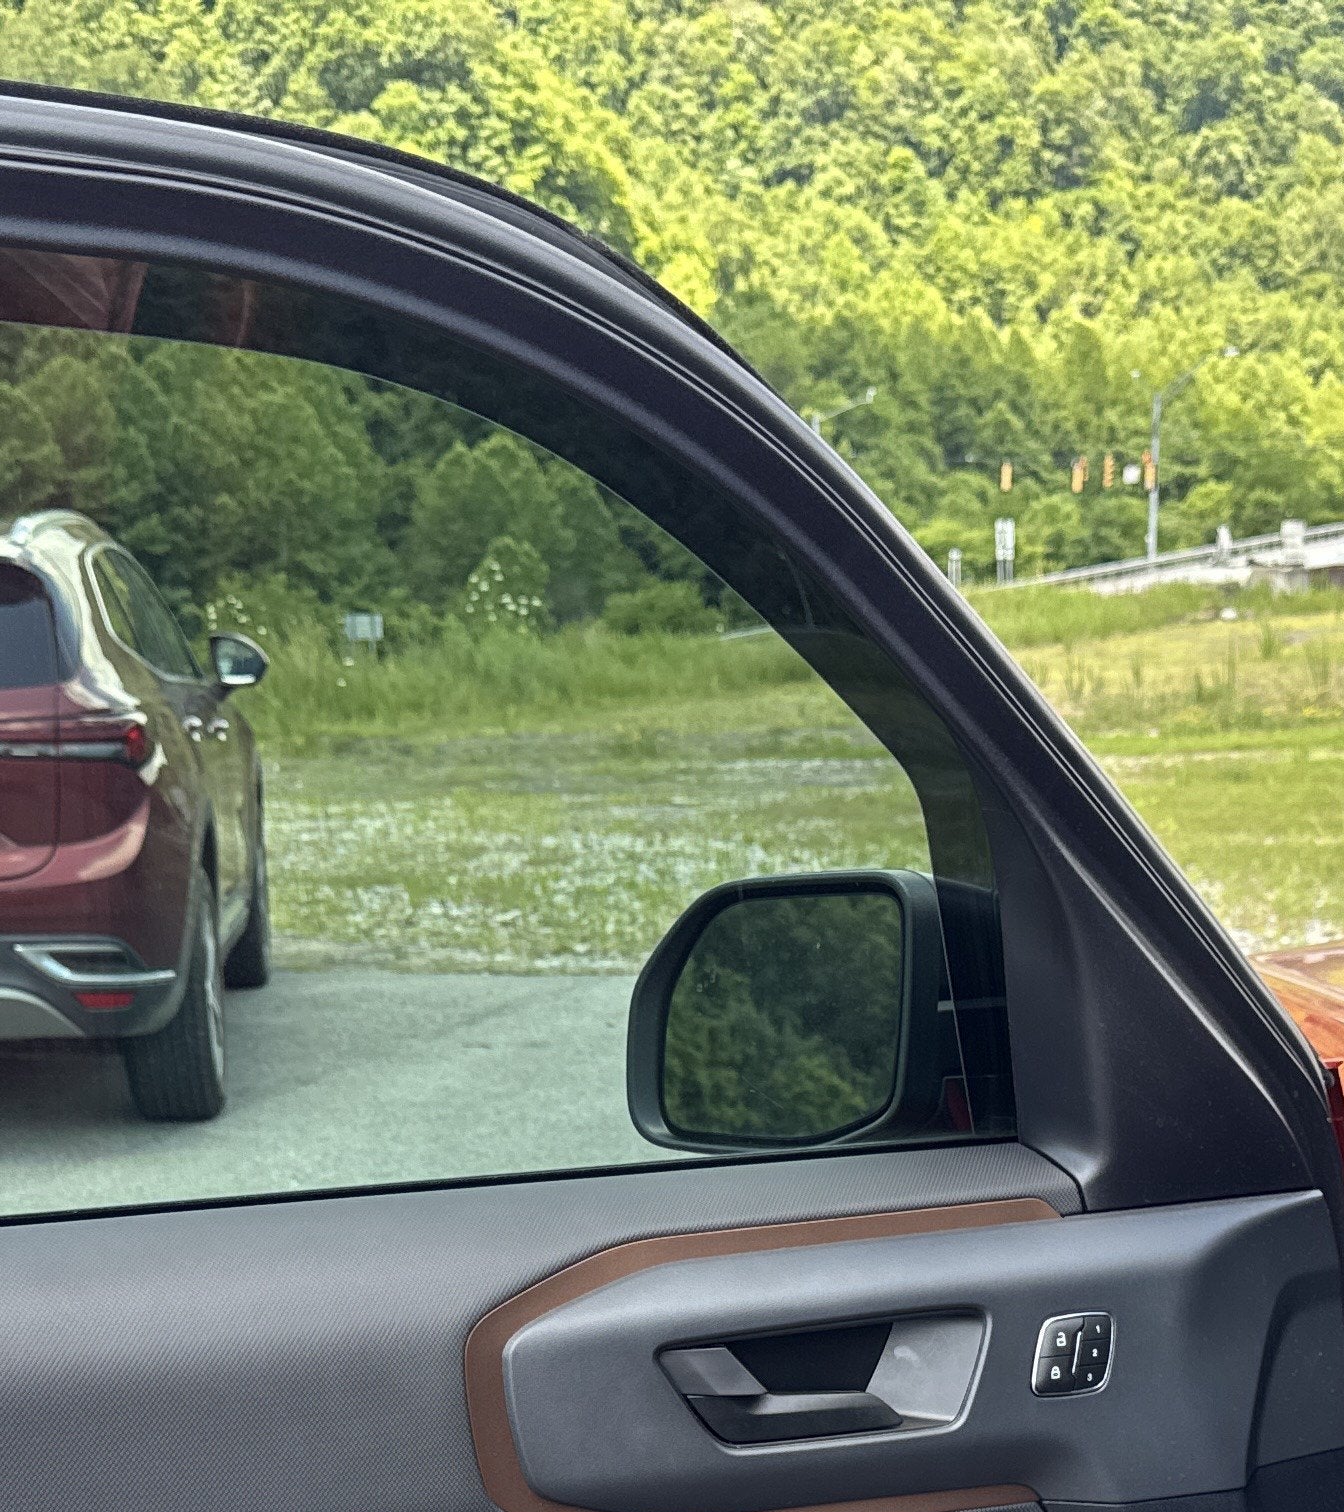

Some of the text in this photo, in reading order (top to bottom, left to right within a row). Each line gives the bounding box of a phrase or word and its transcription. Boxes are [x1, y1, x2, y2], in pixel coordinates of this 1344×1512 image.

[1095, 1324, 1101, 1334] 1
[1092, 1348, 1098, 1357] 2
[1087, 1372, 1093, 1382] 3
